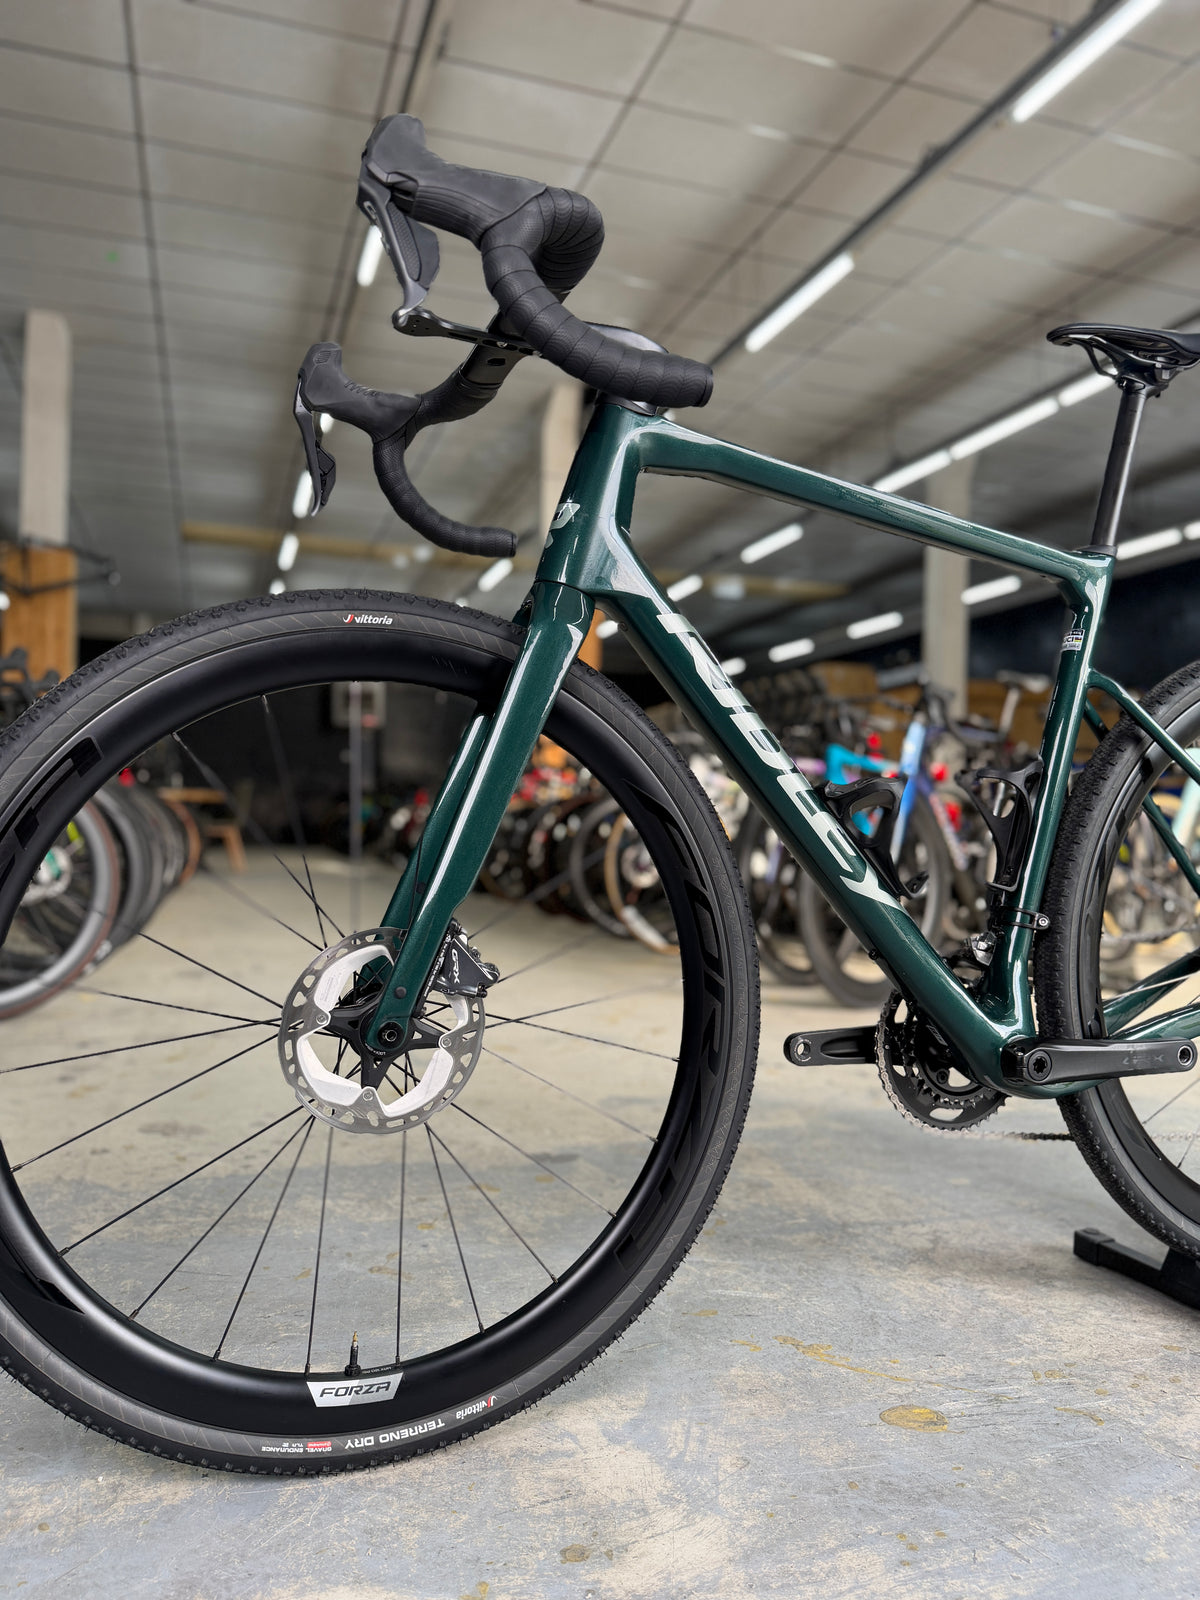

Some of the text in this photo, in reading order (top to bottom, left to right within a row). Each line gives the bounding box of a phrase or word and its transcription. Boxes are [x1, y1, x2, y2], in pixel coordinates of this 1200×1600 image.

[354, 614, 394, 625] vittoria
[656, 613, 908, 914] RIDLEY
[614, 778, 725, 1270] FORZA
[319, 1381, 391, 1398] FORZA
[455, 1399, 488, 1420] vittoria
[344, 1418, 445, 1450] TERRENO DRY
[261, 1445, 332, 1453] GRAVEL ENDURANCE
